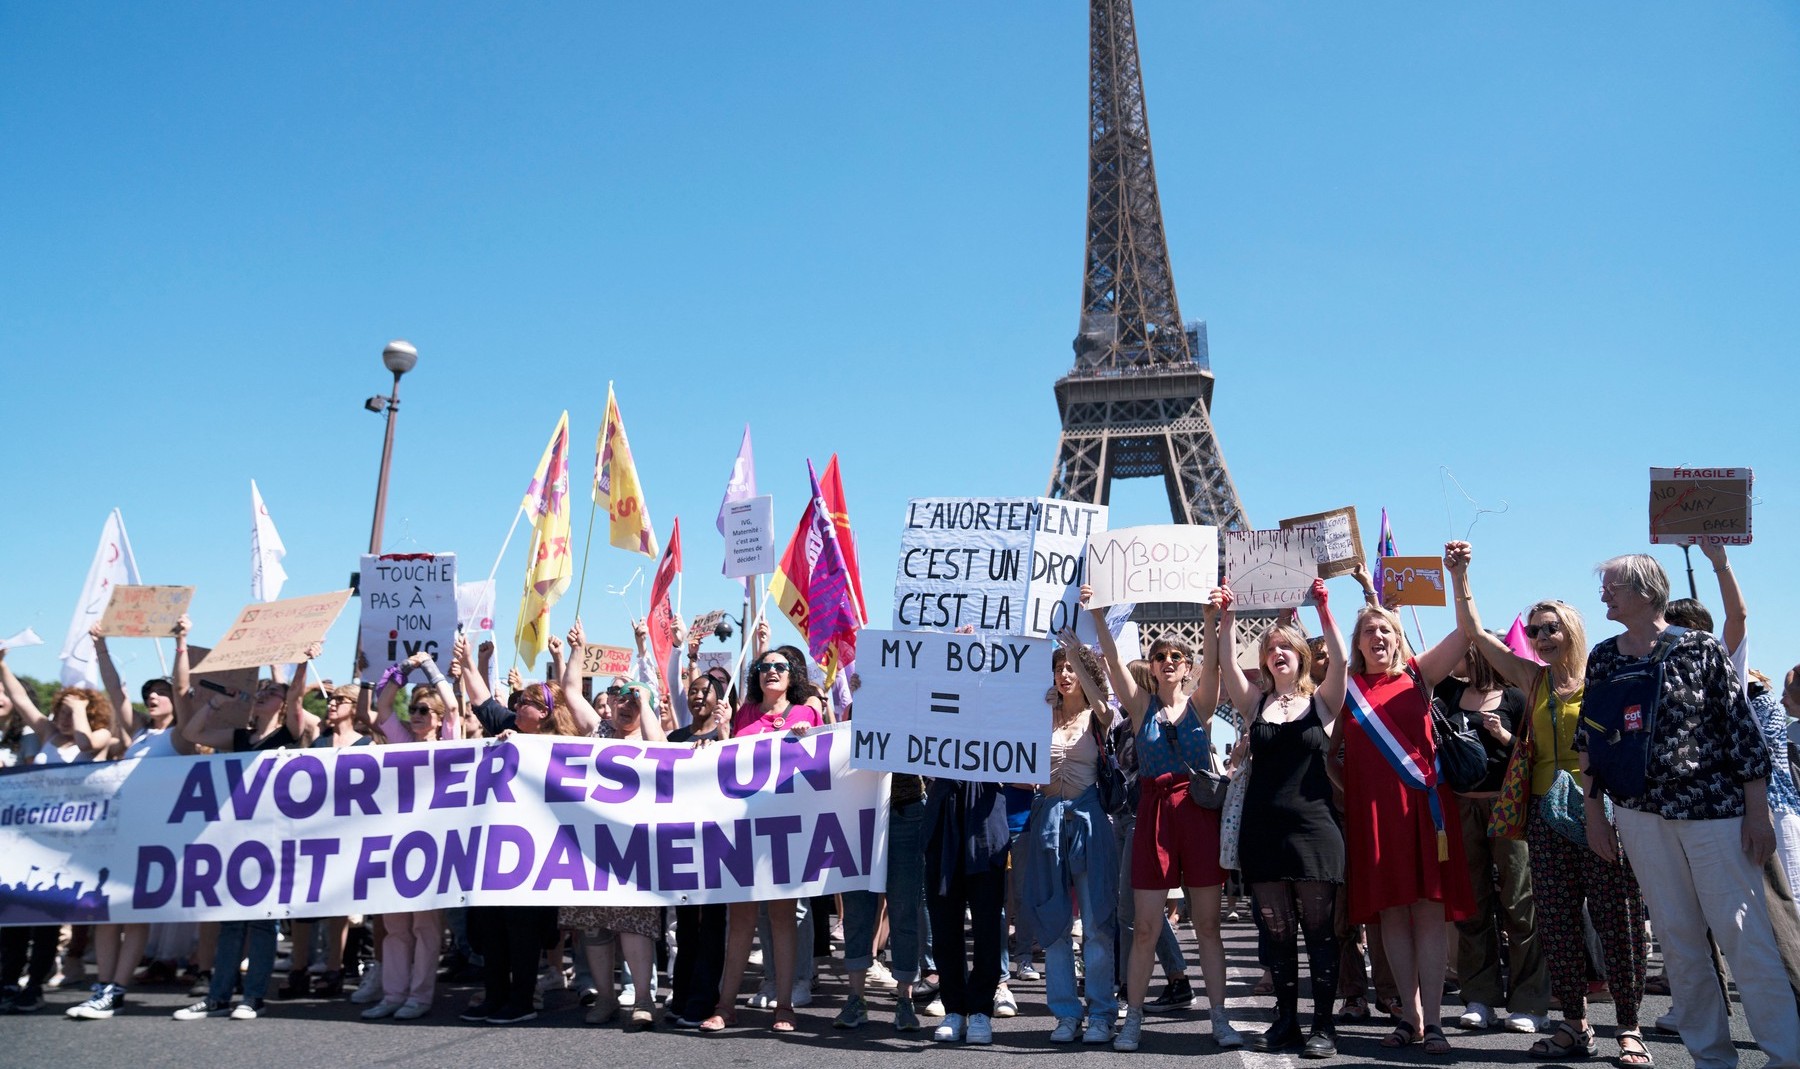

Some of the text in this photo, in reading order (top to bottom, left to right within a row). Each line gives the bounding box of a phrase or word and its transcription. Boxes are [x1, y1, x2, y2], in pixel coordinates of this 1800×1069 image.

[1673, 469, 1736, 478] FRAGILE
[1654, 486, 1677, 501] NO
[1680, 496, 1717, 512] WAY
[908, 501, 1099, 536] L'AVORTEMENT
[1702, 518, 1740, 531] BACK
[1688, 535, 1750, 544] FRAGLE
[376, 563, 451, 582] TOUCHE
[903, 547, 1086, 588] C'EST UN DROI
[1088, 536, 1208, 601] MY BODY
[370, 585, 426, 609] PAS À
[396, 614, 432, 630] MON
[899, 592, 968, 627] C'EST
[980, 595, 1011, 630] LA
[1033, 597, 1079, 636] LOI
[881, 639, 1031, 674] MY BODY
[1624, 710, 1641, 721] cgt
[855, 730, 1037, 774] MY DECISION
[167, 733, 833, 824] AVORTER EST UN
[1, 801, 97, 826] décident
[133, 838, 340, 910] DROIT
